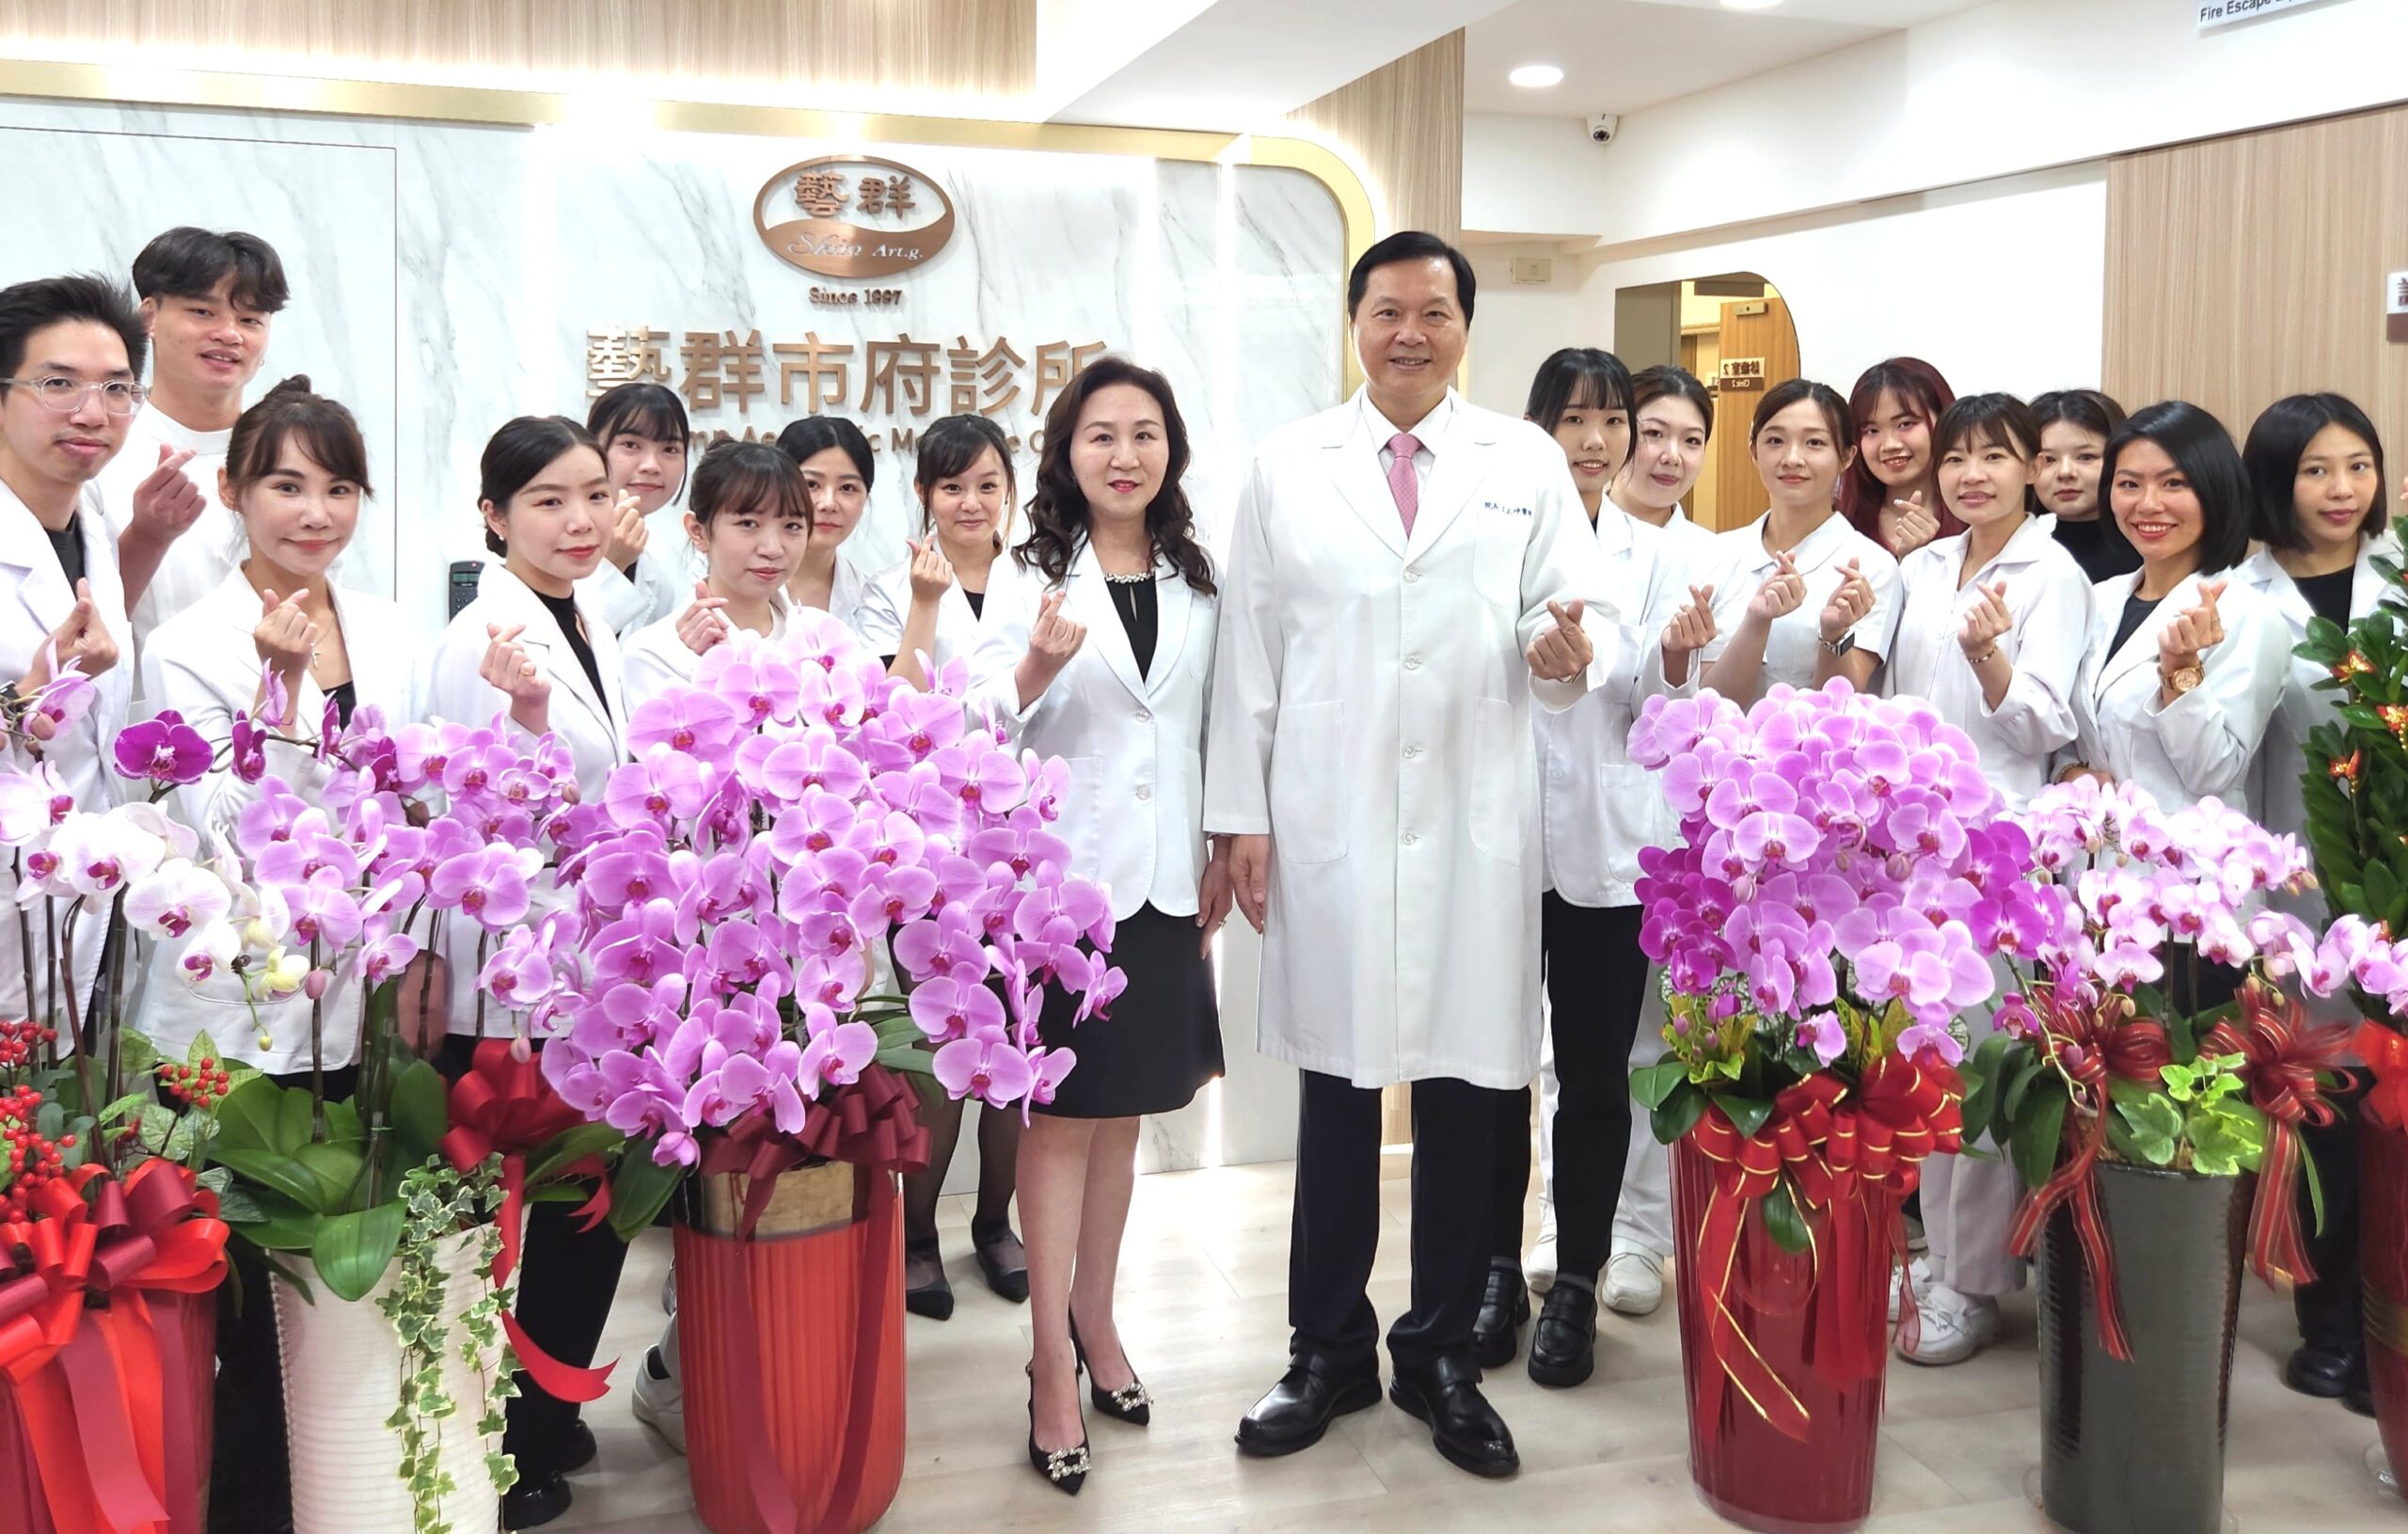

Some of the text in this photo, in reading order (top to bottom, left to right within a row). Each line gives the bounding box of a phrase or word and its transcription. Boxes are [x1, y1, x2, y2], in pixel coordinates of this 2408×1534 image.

[2200, 7, 2223, 22] Fire
[795, 171, 916, 219] 藝群
[787, 233, 863, 256] Skin
[809, 286, 903, 306] Since 1997
[586, 324, 1108, 416] 藝群市府診所
